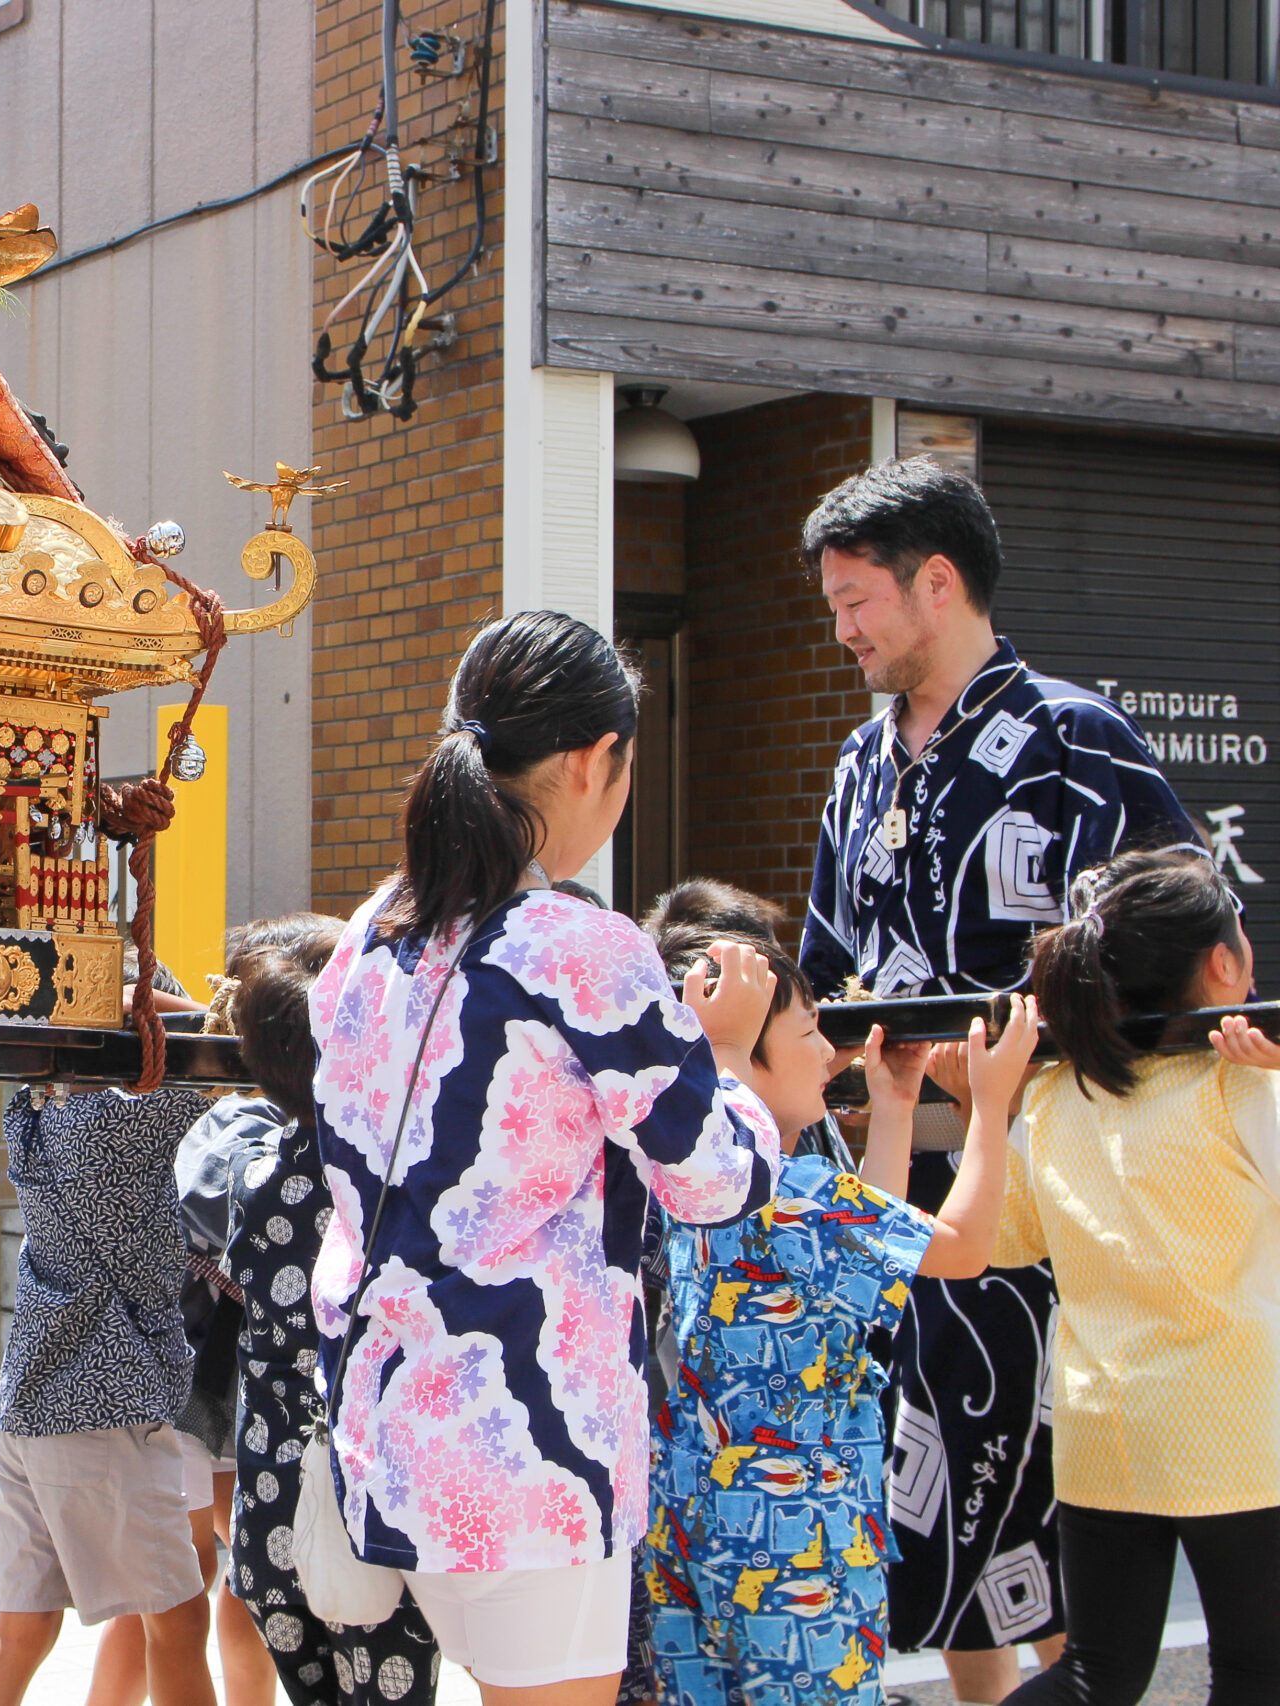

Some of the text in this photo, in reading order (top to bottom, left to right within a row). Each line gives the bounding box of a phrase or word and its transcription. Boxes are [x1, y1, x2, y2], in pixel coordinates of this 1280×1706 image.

[1096, 680, 1239, 721] Tempura
[1145, 731, 1268, 766] NMURO
[1206, 804, 1266, 883] 天
